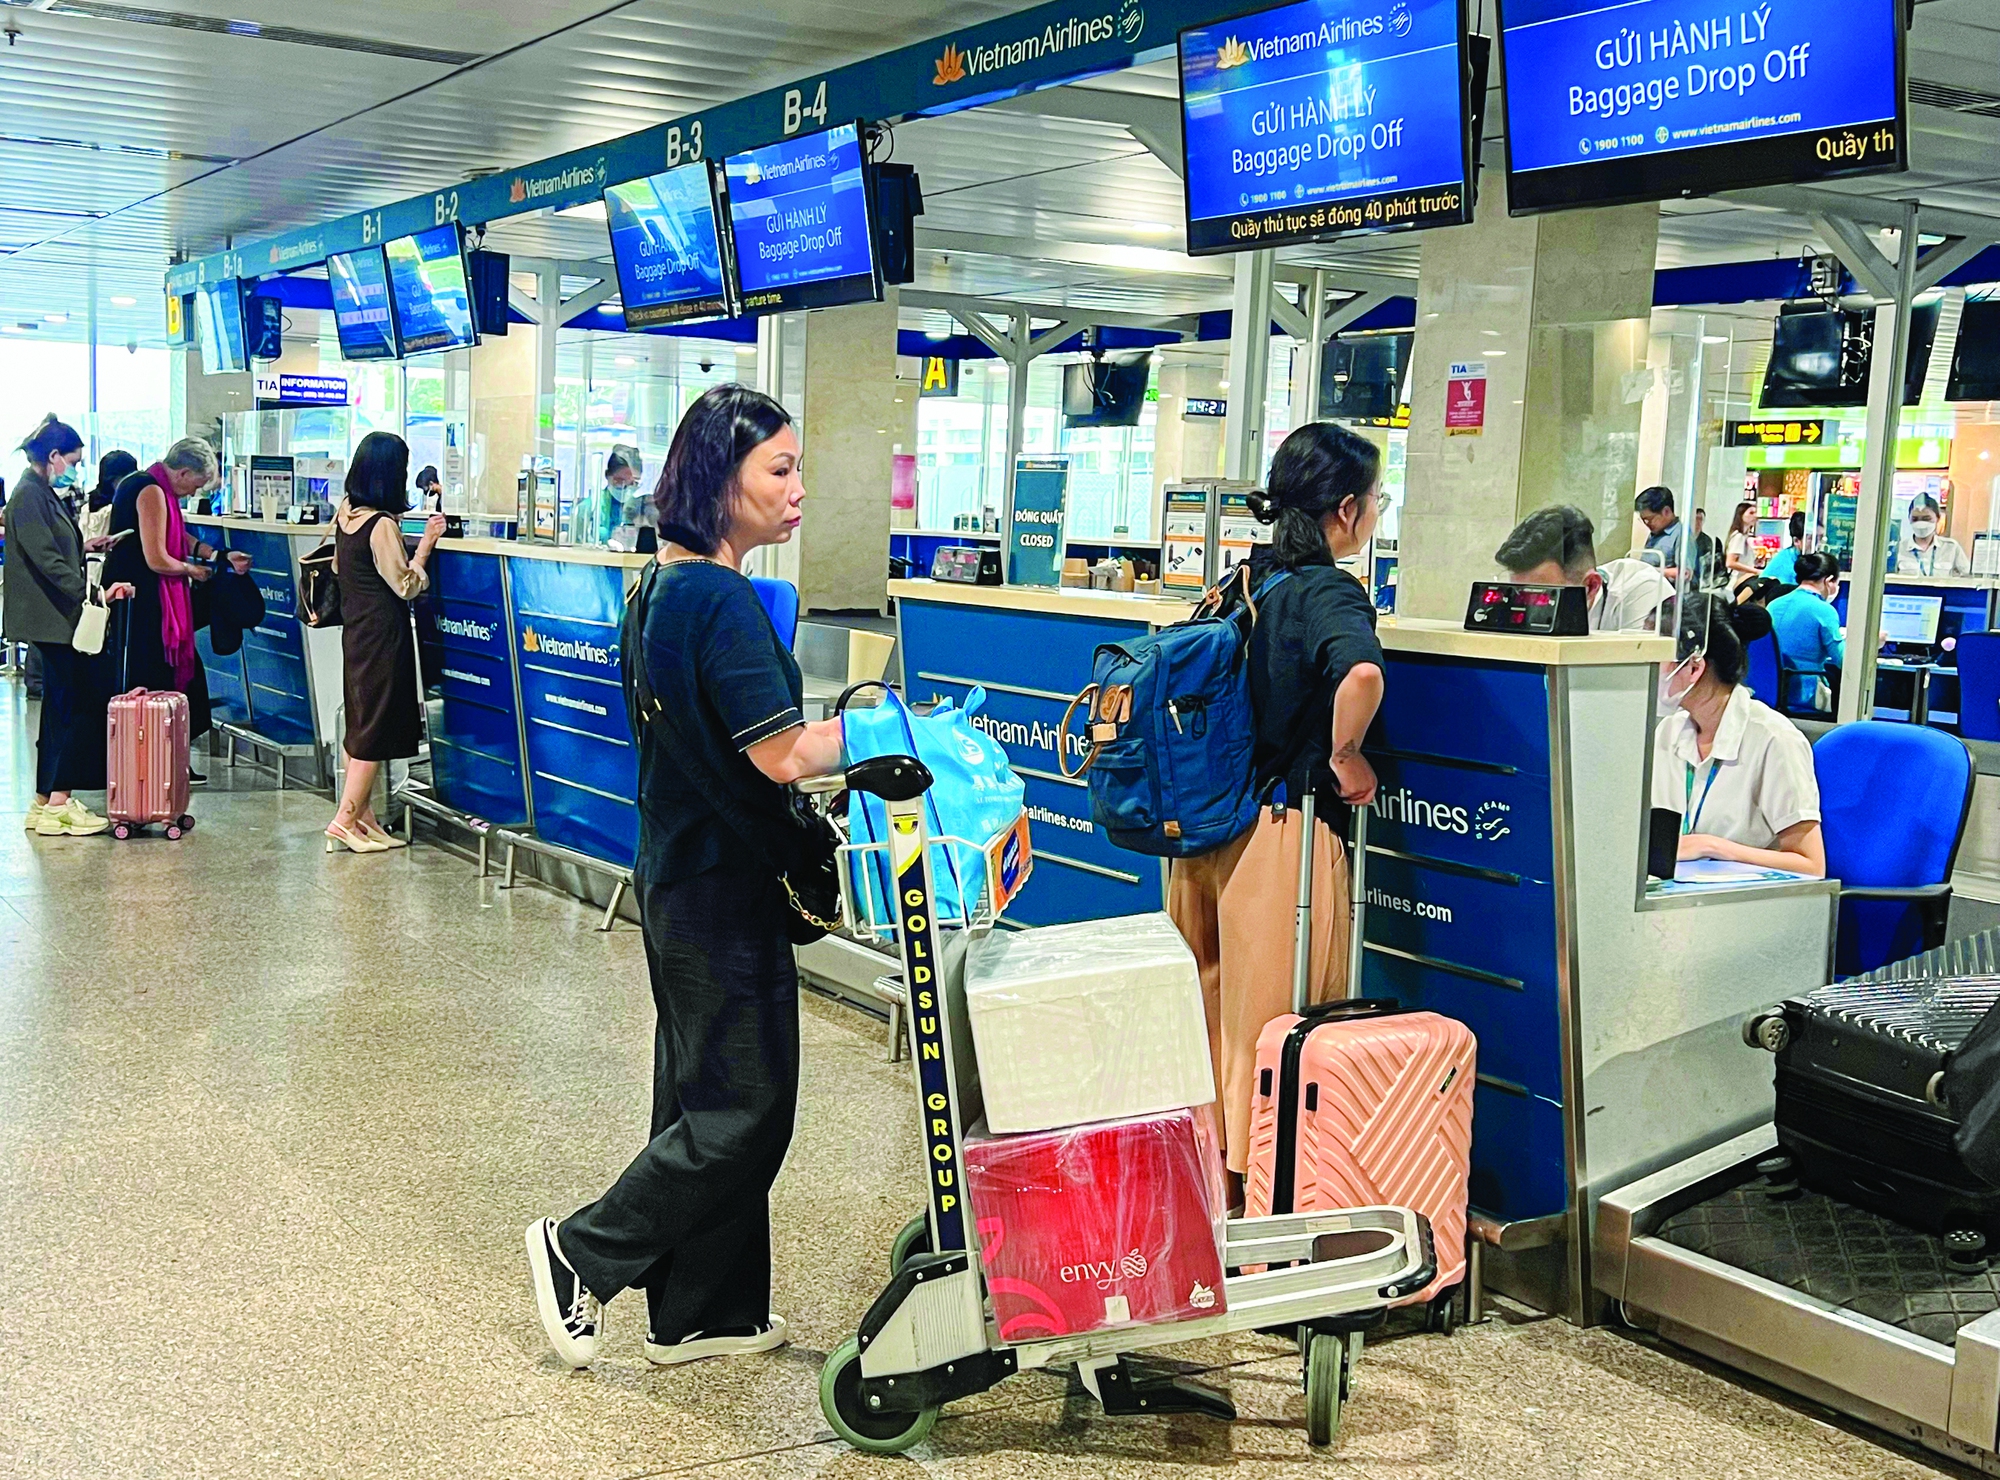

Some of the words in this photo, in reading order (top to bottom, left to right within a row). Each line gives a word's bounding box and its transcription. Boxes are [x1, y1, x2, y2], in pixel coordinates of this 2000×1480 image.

[967, 36, 1040, 76] Vietnam
[1040, 14, 1113, 57] Airlines
[1247, 32, 1317, 62] Vietnam
[1317, 15, 1384, 47] Airlines
[1595, 27, 1642, 70] GỬI
[1651, 16, 1731, 62] HÀNH
[1740, 2, 1772, 44] LÝ
[1569, 76, 1680, 119] Baggage
[1687, 61, 1756, 96] Drop
[1763, 42, 1811, 83] Off
[783, 80, 827, 135] B-4
[1252, 101, 1286, 137] GỬI
[1291, 96, 1348, 129] HÀNH
[1354, 84, 1377, 116] LÝ
[667, 120, 702, 167] B-3
[1232, 142, 1312, 177] Baggage
[1317, 132, 1366, 161] Drop
[1371, 118, 1404, 150] Off
[1594, 137, 1619, 151] 1900
[1621, 134, 1644, 147] 1100
[1672, 112, 1802, 140] www.vietnamairlines.com
[1816, 130, 1869, 161] Quầy
[1872, 129, 1895, 152] th
[435, 191, 459, 226] B-2
[786, 207, 815, 231] HÀNH
[815, 202, 827, 225] LÝ
[1231, 217, 1261, 240] Quầy
[1264, 212, 1284, 234] thủ
[1286, 214, 1307, 234] tục
[1309, 209, 1326, 228] sẽ
[1328, 206, 1362, 229] đóng
[1365, 201, 1383, 220] 40
[1385, 195, 1417, 221] phút
[1420, 190, 1460, 214] trước
[362, 211, 382, 244] B-1
[759, 239, 799, 263] Baggage
[800, 233, 825, 254] Drop
[826, 226, 842, 247] Off
[223, 252, 243, 278] B-1a
[634, 260, 667, 283] Baggage
[667, 257, 687, 277] Drop
[687, 253, 700, 271] Off
[257, 379, 278, 391] TIA
[281, 377, 346, 390] INFORMATION
[924, 356, 946, 390] A
[1451, 364, 1467, 374] TIA
[1015, 509, 1040, 523] ĐÓNG
[1020, 534, 1054, 547] CLOSED
[904, 888, 940, 1060] GOLDSUN
[927, 1092, 957, 1213] GROUP
[1060, 1259, 1123, 1290] envy
